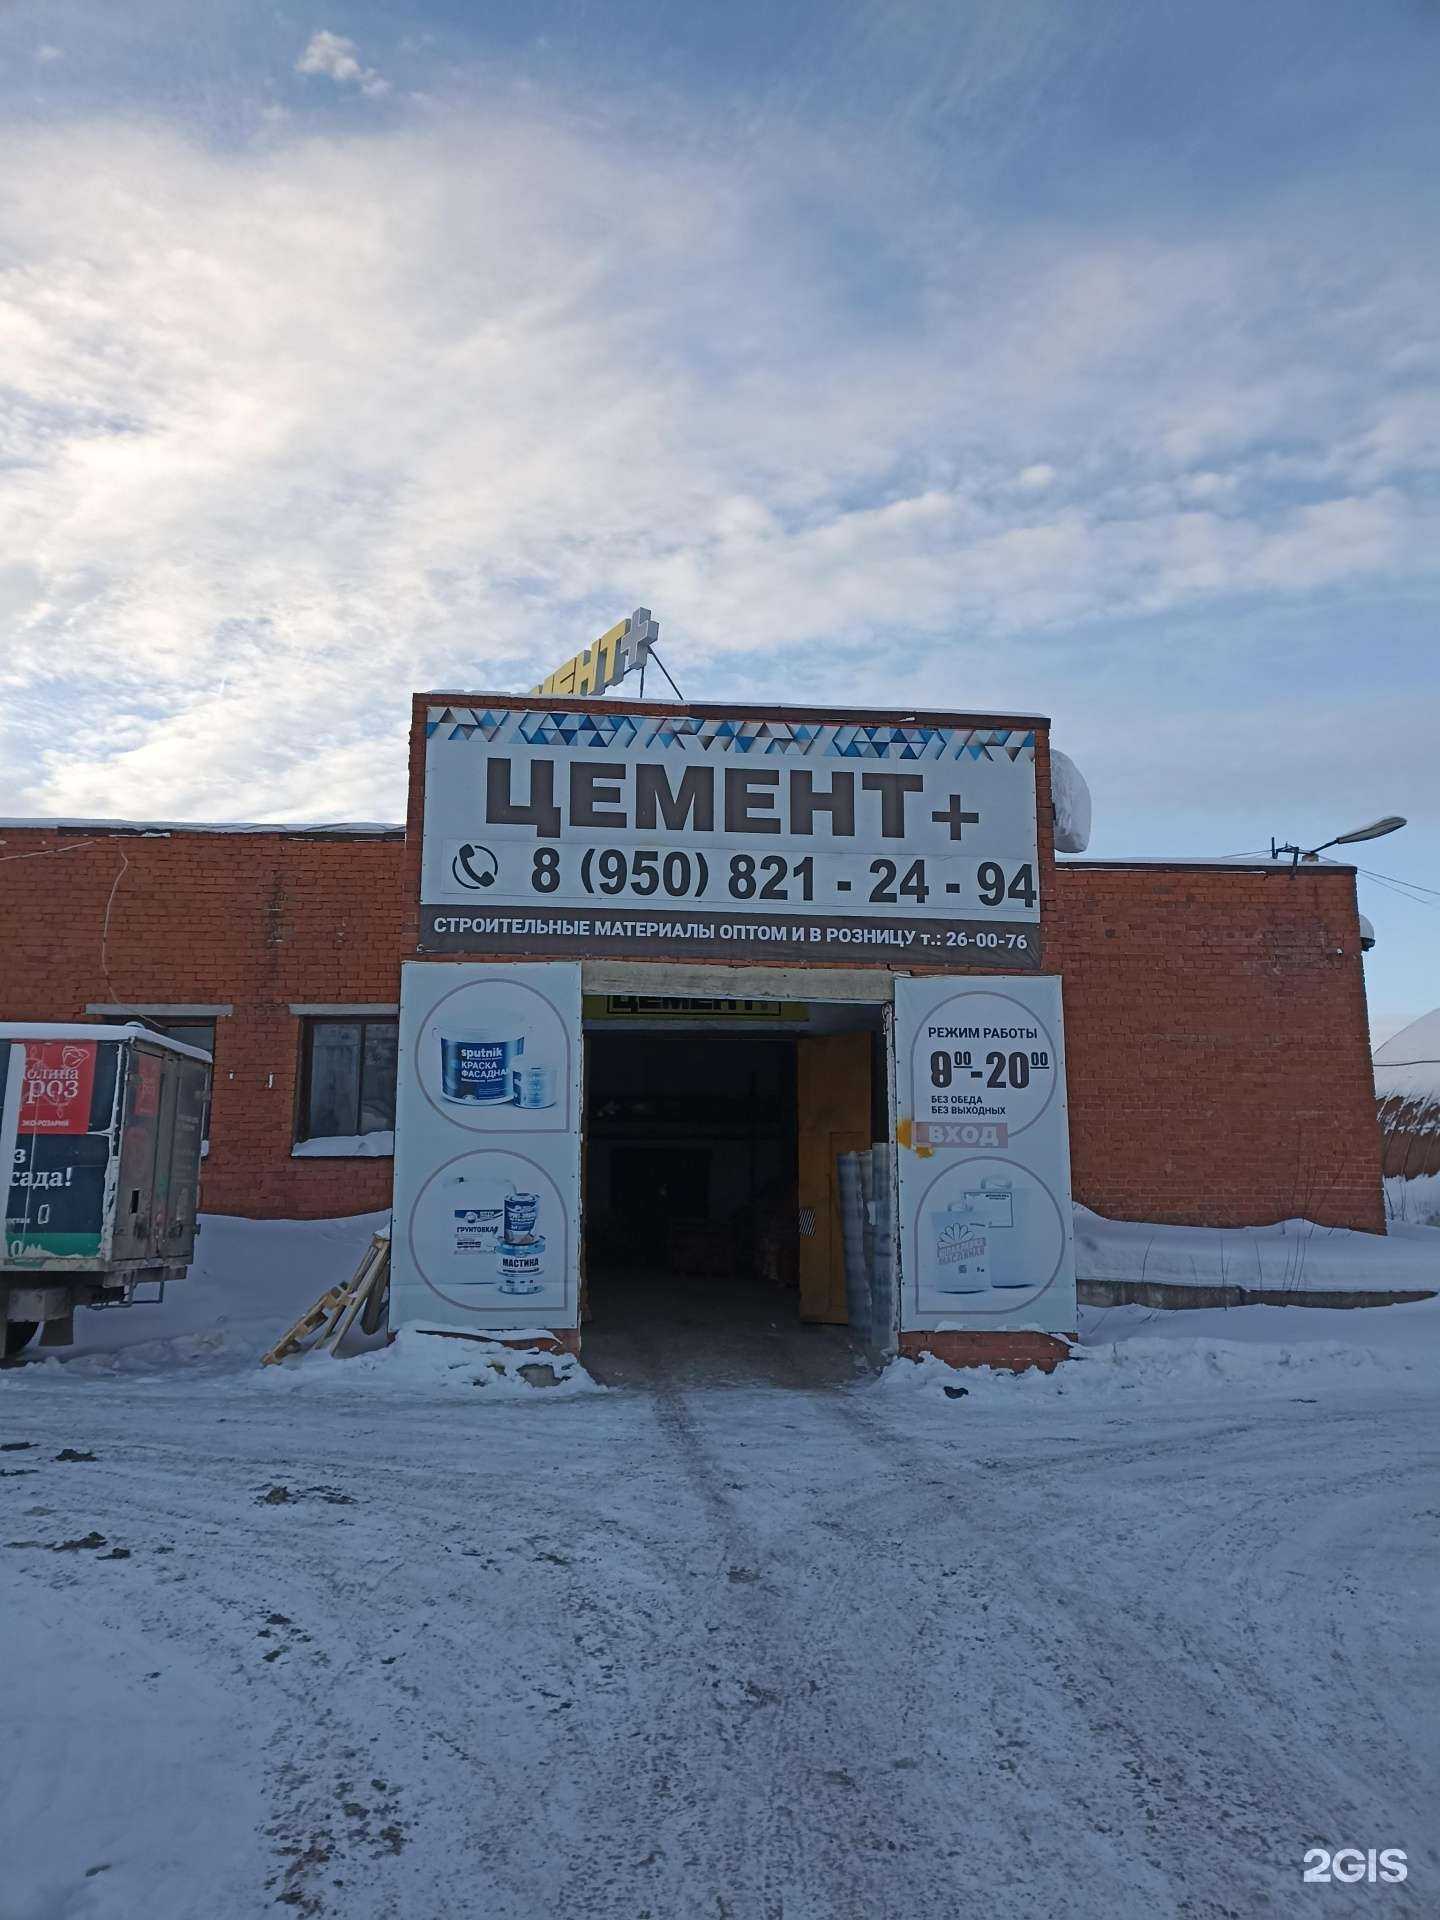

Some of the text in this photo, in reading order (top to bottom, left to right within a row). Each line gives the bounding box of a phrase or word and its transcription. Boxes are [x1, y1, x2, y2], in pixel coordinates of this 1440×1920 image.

[531, 847, 561, 893] 8
[581, 848, 709, 898] (950)
[728, 854, 814, 902] 821
[869, 859, 930, 904] 24
[977, 861, 1037, 908] 94
[433, 917, 590, 936] СТРОИТЕЛЬНЫЕ
[594, 920, 715, 939] МАТЕРИАЛЫ
[719, 924, 787, 941] ОПТОМ
[791, 927, 805, 941] И
[809, 928, 822, 942] В
[826, 929, 916, 949] РОЗНИЦУ
[945, 931, 1028, 949] 26-00-76
[928, 1027, 1038, 1039] РЕЖИМ РАБОТЫ
[461, 1047, 503, 1060] sputnik
[461, 1061, 498, 1070] КРАСКА
[24, 1067, 79, 1080] олина
[25, 1079, 79, 1104] роз
[931, 1096, 983, 1106] БЕЗ ОБЕДА
[931, 1106, 1006, 1116] БЕЗ ВЫХОДНЫХ
[928, 1125, 999, 1147] ВХОД
